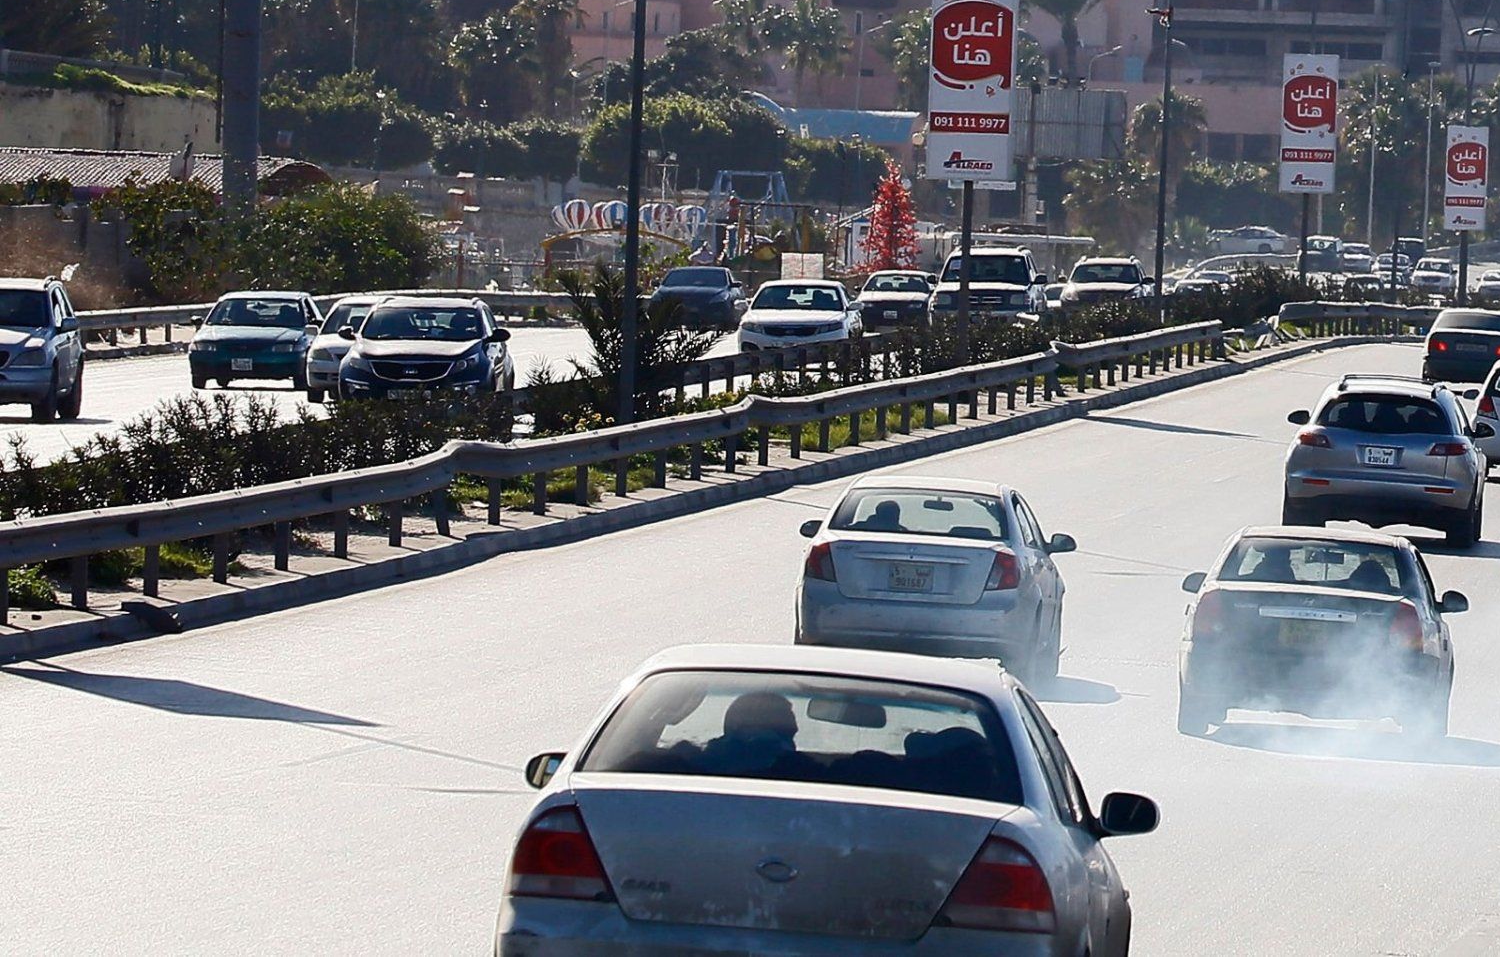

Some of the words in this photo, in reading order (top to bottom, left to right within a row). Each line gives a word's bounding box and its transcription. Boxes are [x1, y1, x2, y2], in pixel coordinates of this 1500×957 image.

[944, 11, 1004, 41] أعلن
[953, 44, 991, 65] هنا
[1290, 82, 1330, 102] أعلن
[1297, 103, 1322, 118] هنا
[934, 116, 954, 127] 091
[957, 117, 976, 127] 111
[979, 118, 1006, 129] 9977
[1452, 146, 1482, 162] أعلن
[1456, 162, 1477, 174] هنا
